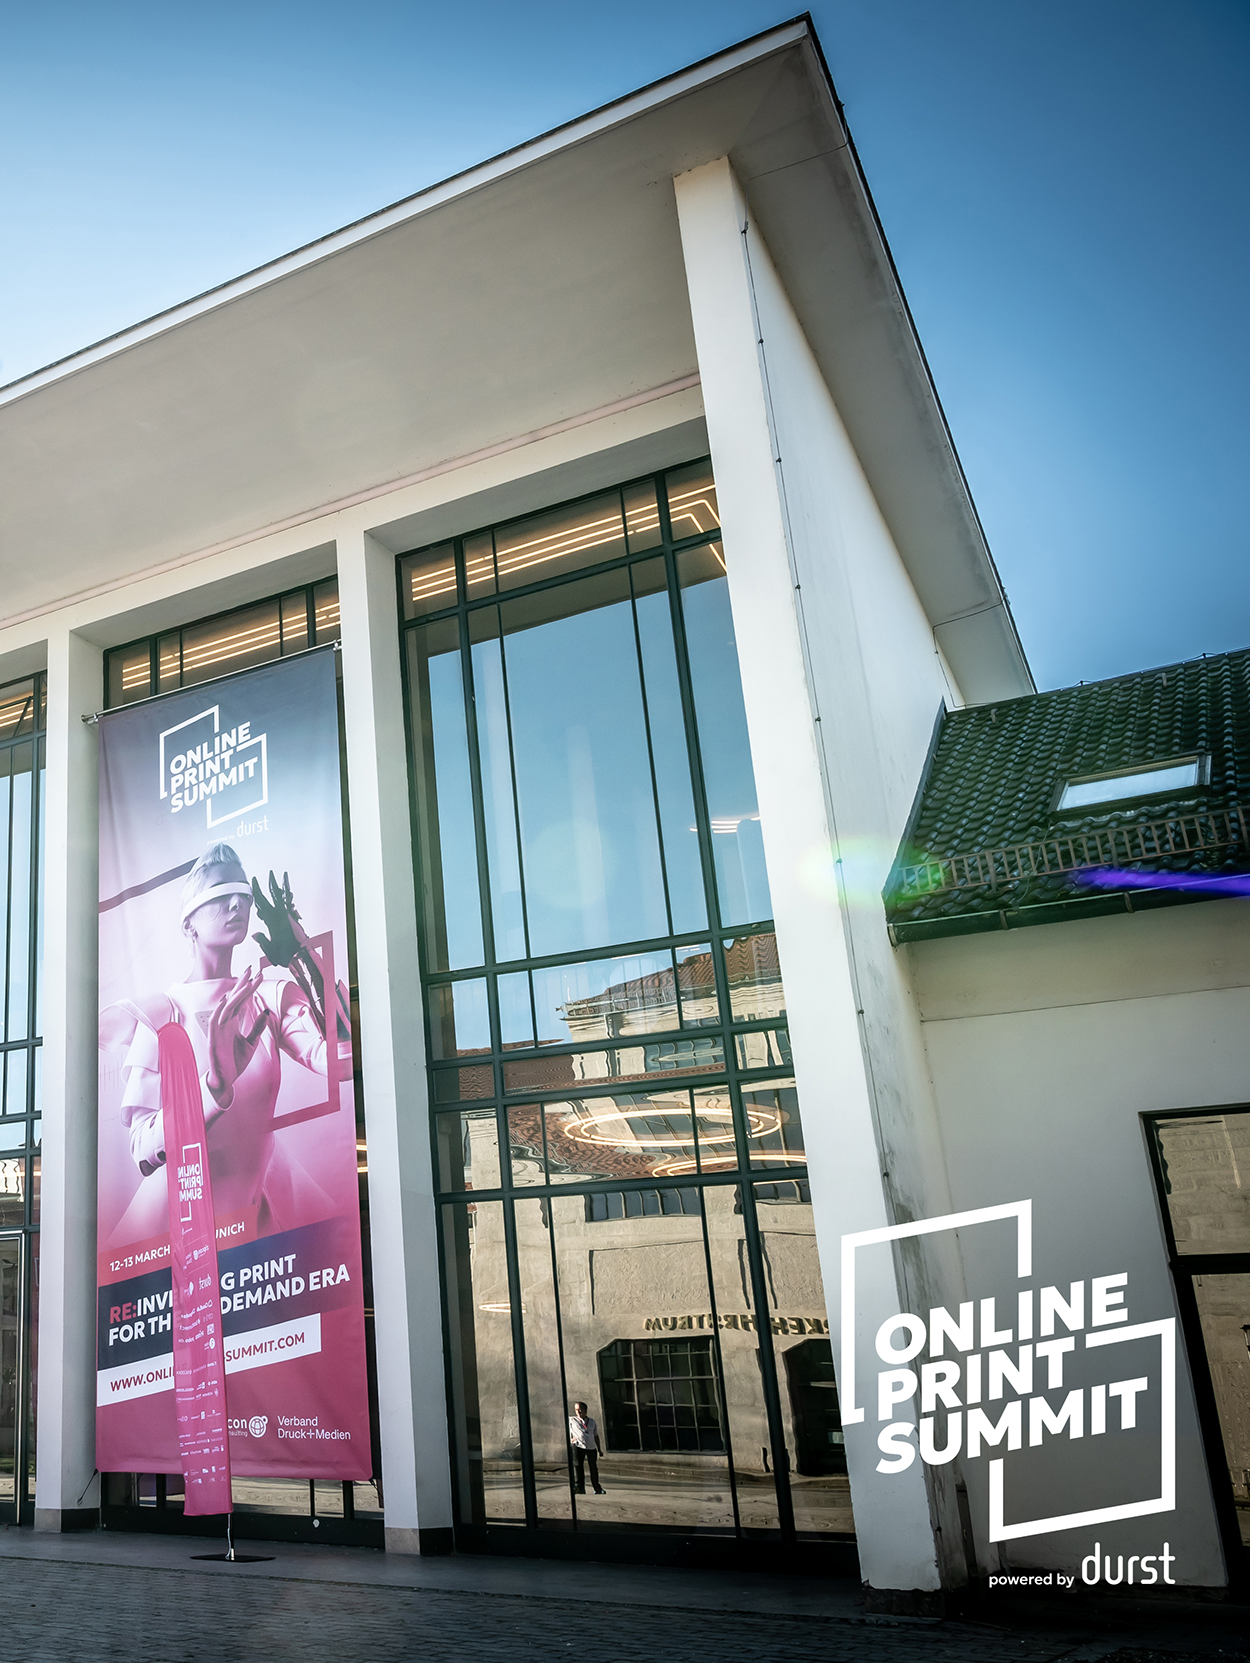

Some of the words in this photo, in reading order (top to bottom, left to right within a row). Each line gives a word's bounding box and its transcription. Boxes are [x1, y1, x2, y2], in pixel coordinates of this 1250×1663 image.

[169, 721, 252, 776] ONLINE
[169, 747, 234, 795] PRINT
[169, 756, 258, 814] SUMMIT
[236, 815, 269, 837] durst
[109, 1256, 134, 1272] 12-13
[134, 1244, 171, 1265] MARCH
[239, 1253, 297, 1287] PRINT
[108, 1320, 146, 1346] FOR
[148, 1312, 172, 1335] TH
[309, 1263, 350, 1292] ERA
[277, 1415, 318, 1427] Verband
[277, 1428, 351, 1440] Druck+Medien
